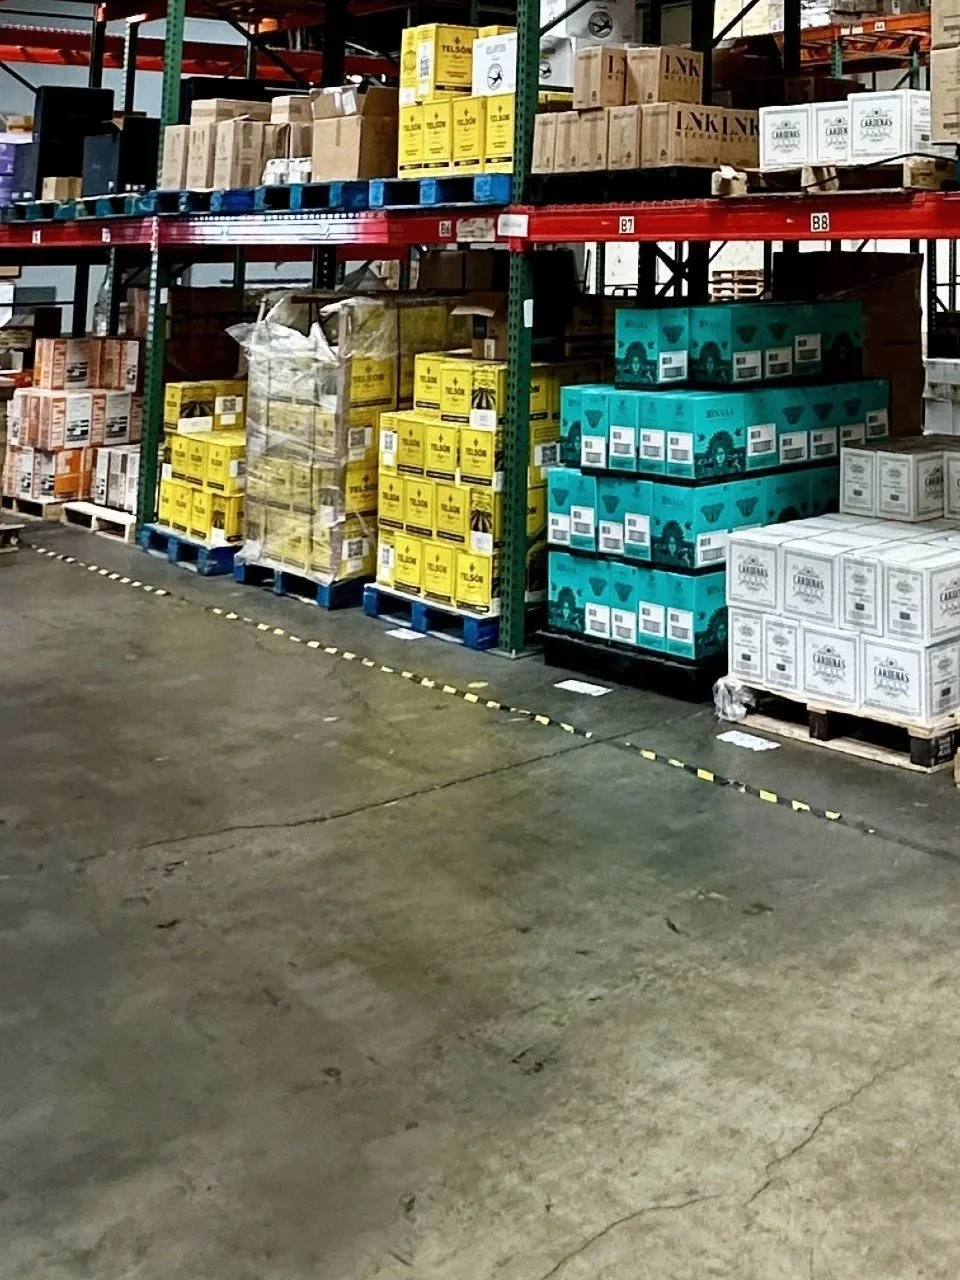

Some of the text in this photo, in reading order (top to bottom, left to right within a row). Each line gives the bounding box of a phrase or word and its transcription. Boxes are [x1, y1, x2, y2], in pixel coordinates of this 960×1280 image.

[860, 117, 893, 128] CARDENAS
[771, 130, 801, 139] CARDENAS
[825, 125, 848, 136] CARDEN
[621, 218, 632, 232] B7
[813, 215, 828, 230] B8
[738, 563, 769, 577] CARDENAS
[792, 574, 825, 590] CARDENAS
[812, 653, 846, 670] CARDENAS
[873, 667, 910, 683] CARDENAS
